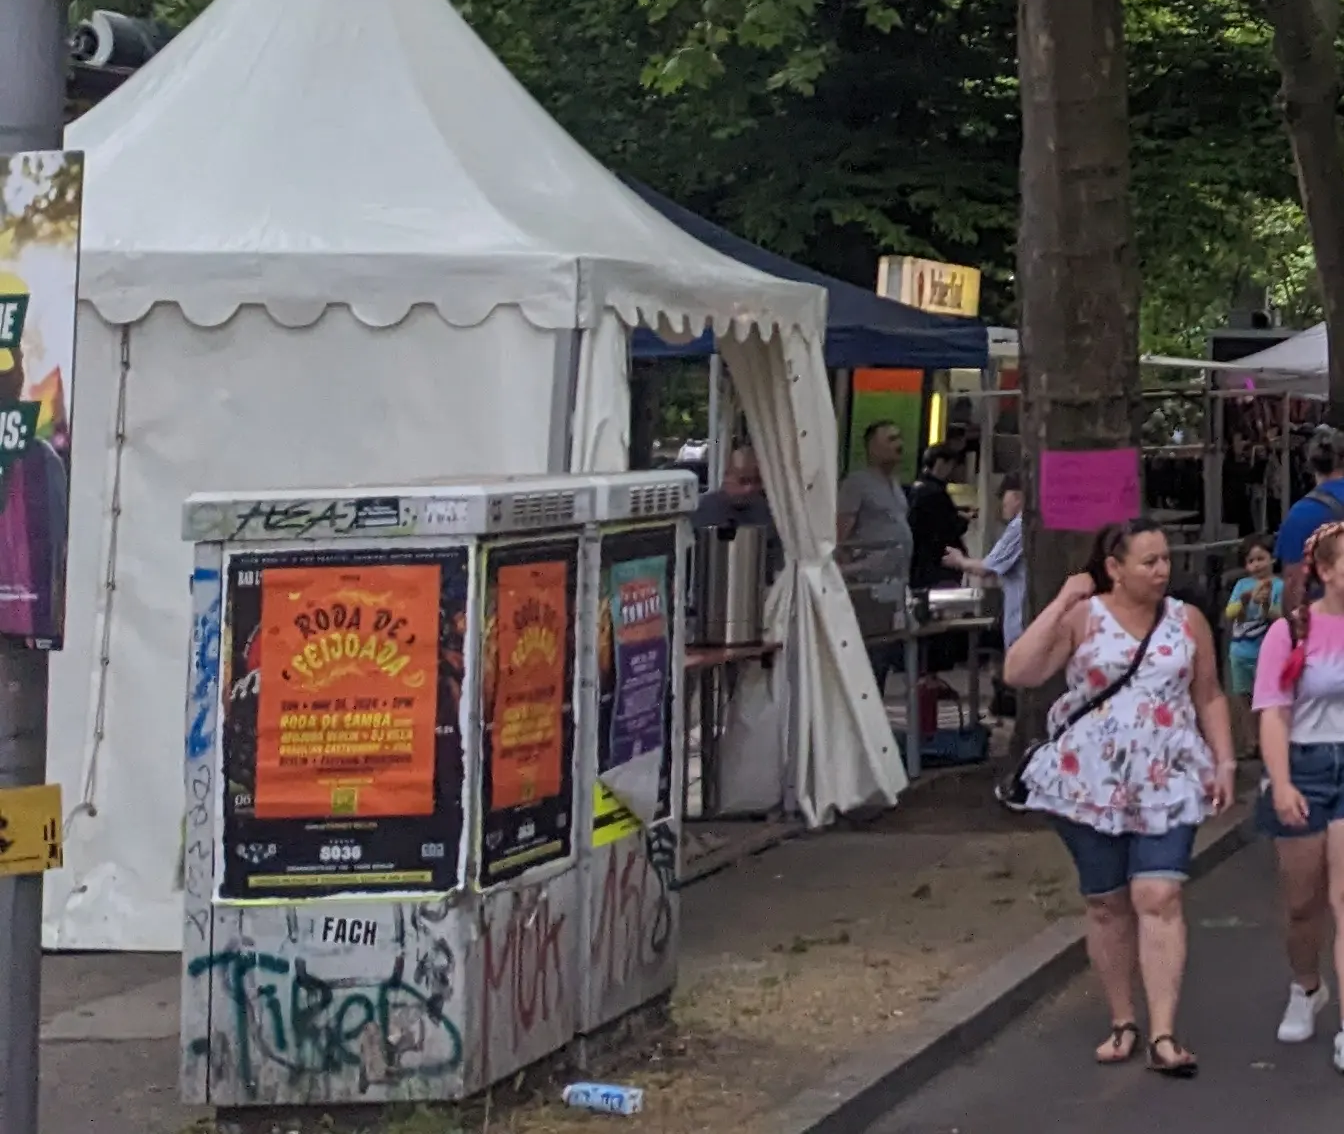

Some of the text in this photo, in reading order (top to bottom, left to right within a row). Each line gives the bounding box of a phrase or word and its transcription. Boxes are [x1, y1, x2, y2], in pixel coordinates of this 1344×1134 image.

[0, 302, 18, 340] E
[0, 410, 27, 450] S:
[295, 603, 409, 640] RODA DE
[291, 632, 411, 677] FEIJOADA
[322, 917, 377, 946] FACH
